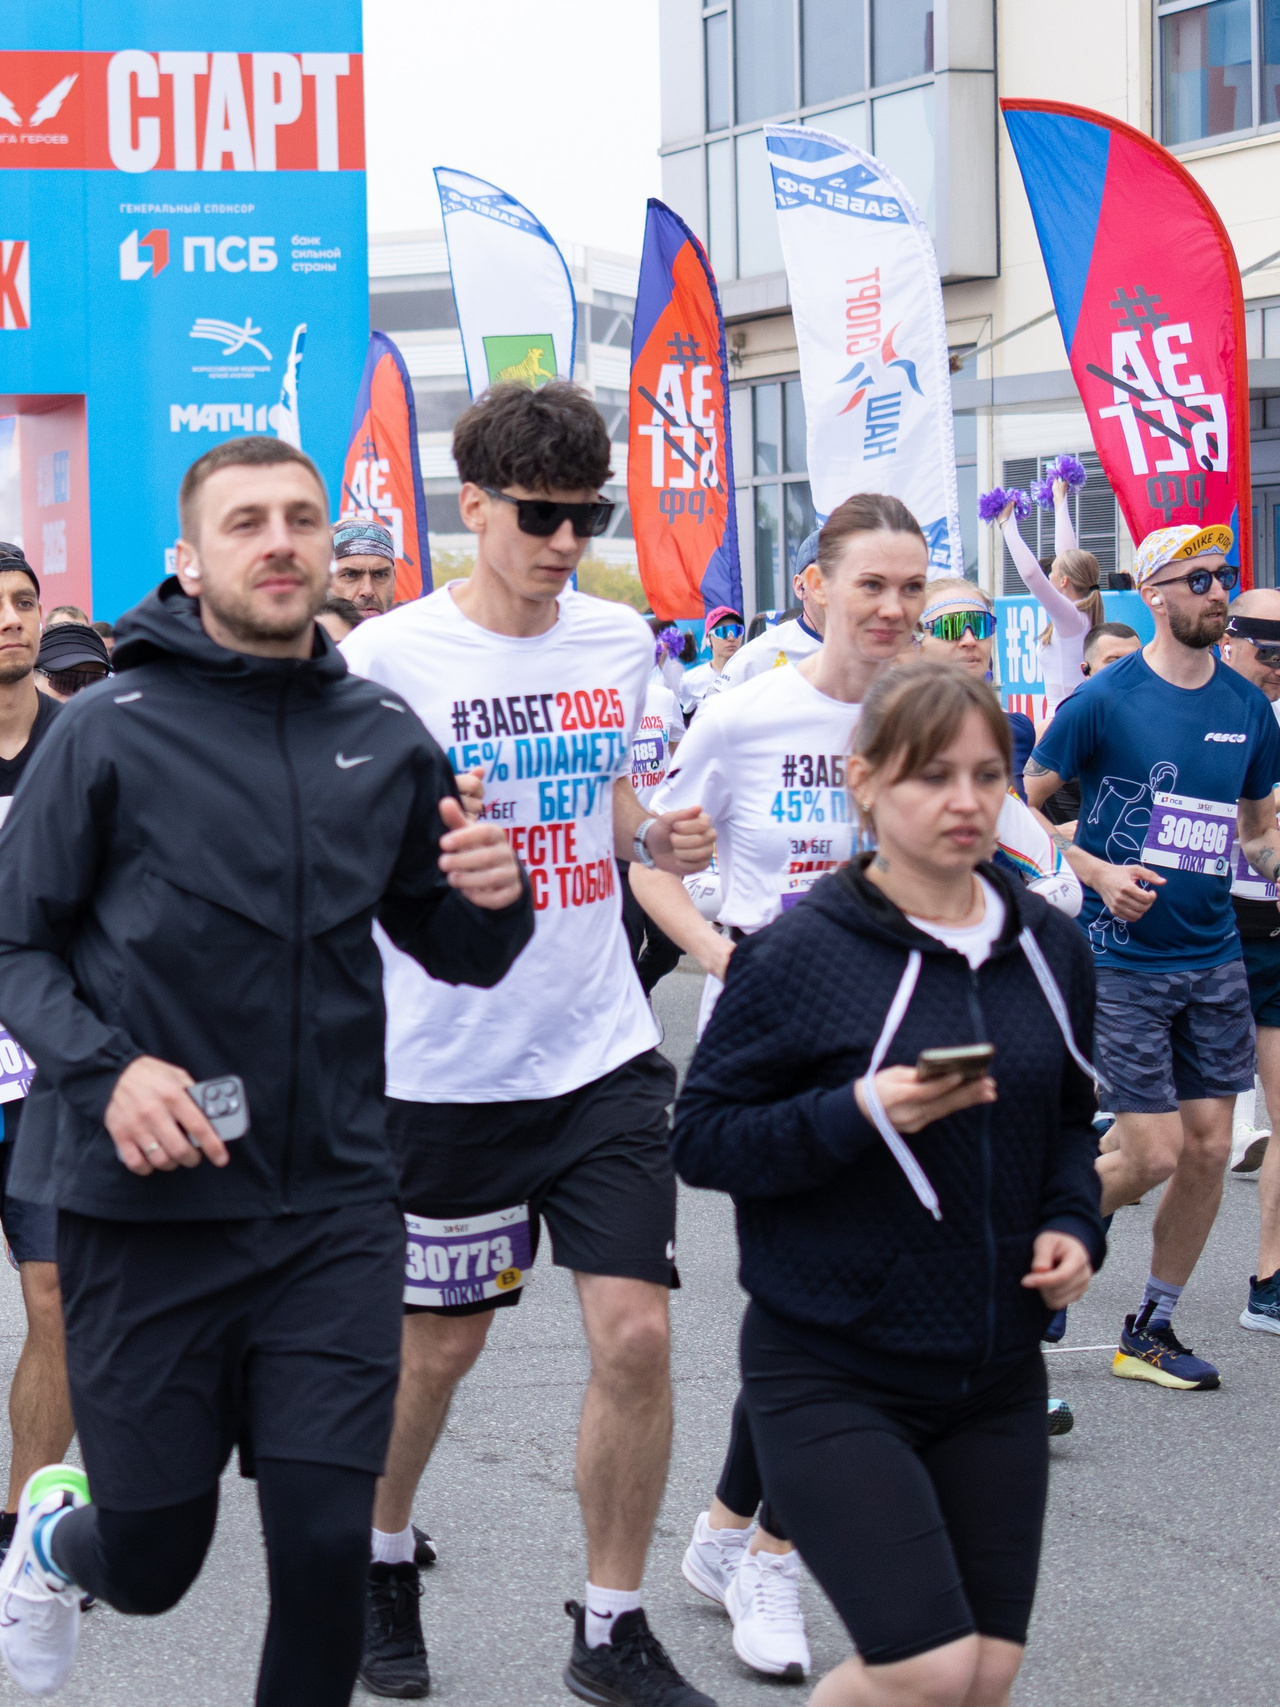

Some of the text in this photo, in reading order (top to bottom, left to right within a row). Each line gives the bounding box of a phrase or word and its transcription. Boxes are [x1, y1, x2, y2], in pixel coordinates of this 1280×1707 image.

[106, 50, 350, 173] СТАРТ
[20, 133, 69, 145] ГЕРОЕВ
[119, 203, 255, 214] ГЕНЕРАЛЬНЫЙ СПОНСОР
[291, 234, 321, 246] банк
[183, 235, 279, 273] ПСБ
[291, 247, 341, 260] сильной
[291, 262, 337, 274] страны
[1204, 732, 1247, 744] FESCO
[1157, 814, 1229, 855] 30896
[1215, 857, 1224, 871] D
[405, 1235, 514, 1284] 30773
[502, 1272, 515, 1285] B
